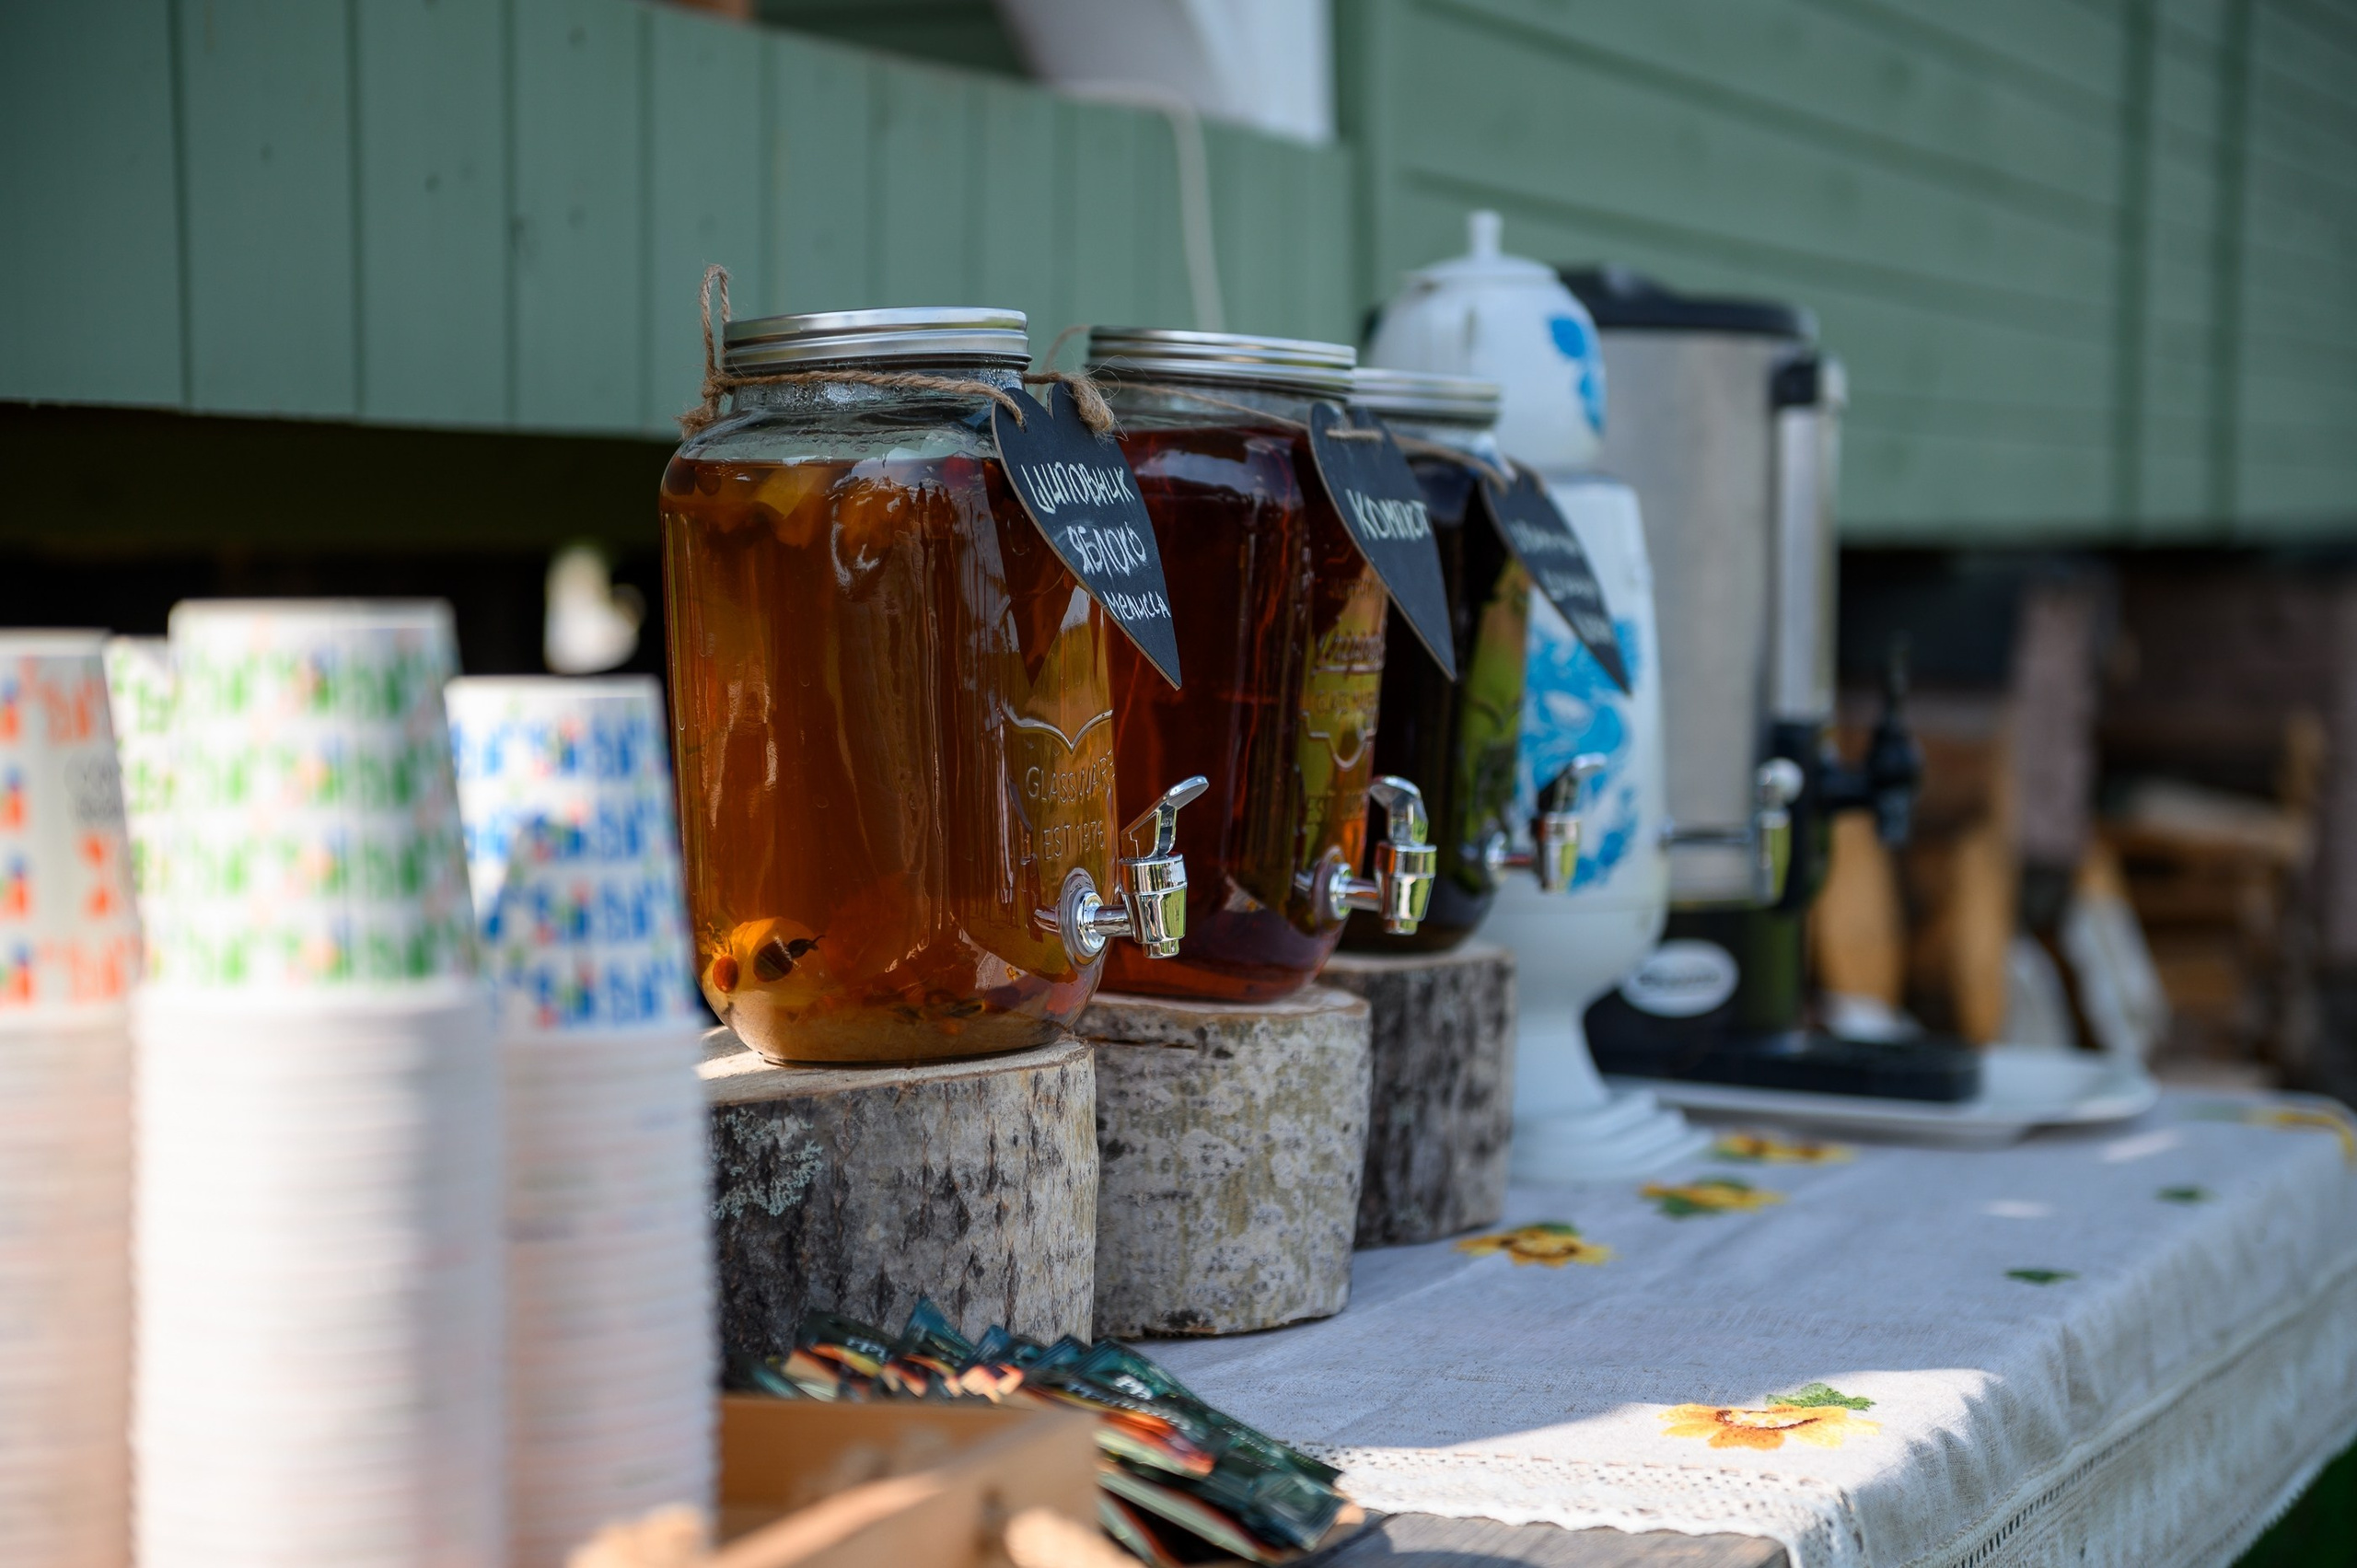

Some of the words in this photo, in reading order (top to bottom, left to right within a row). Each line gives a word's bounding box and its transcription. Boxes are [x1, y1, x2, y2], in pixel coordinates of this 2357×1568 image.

[1020, 461, 1135, 515] ШИПОВНИК
[1345, 488, 1431, 540] КОМПОТ
[1066, 521, 1147, 578] ЯБЛОКО
[1043, 824, 1071, 861] EST
